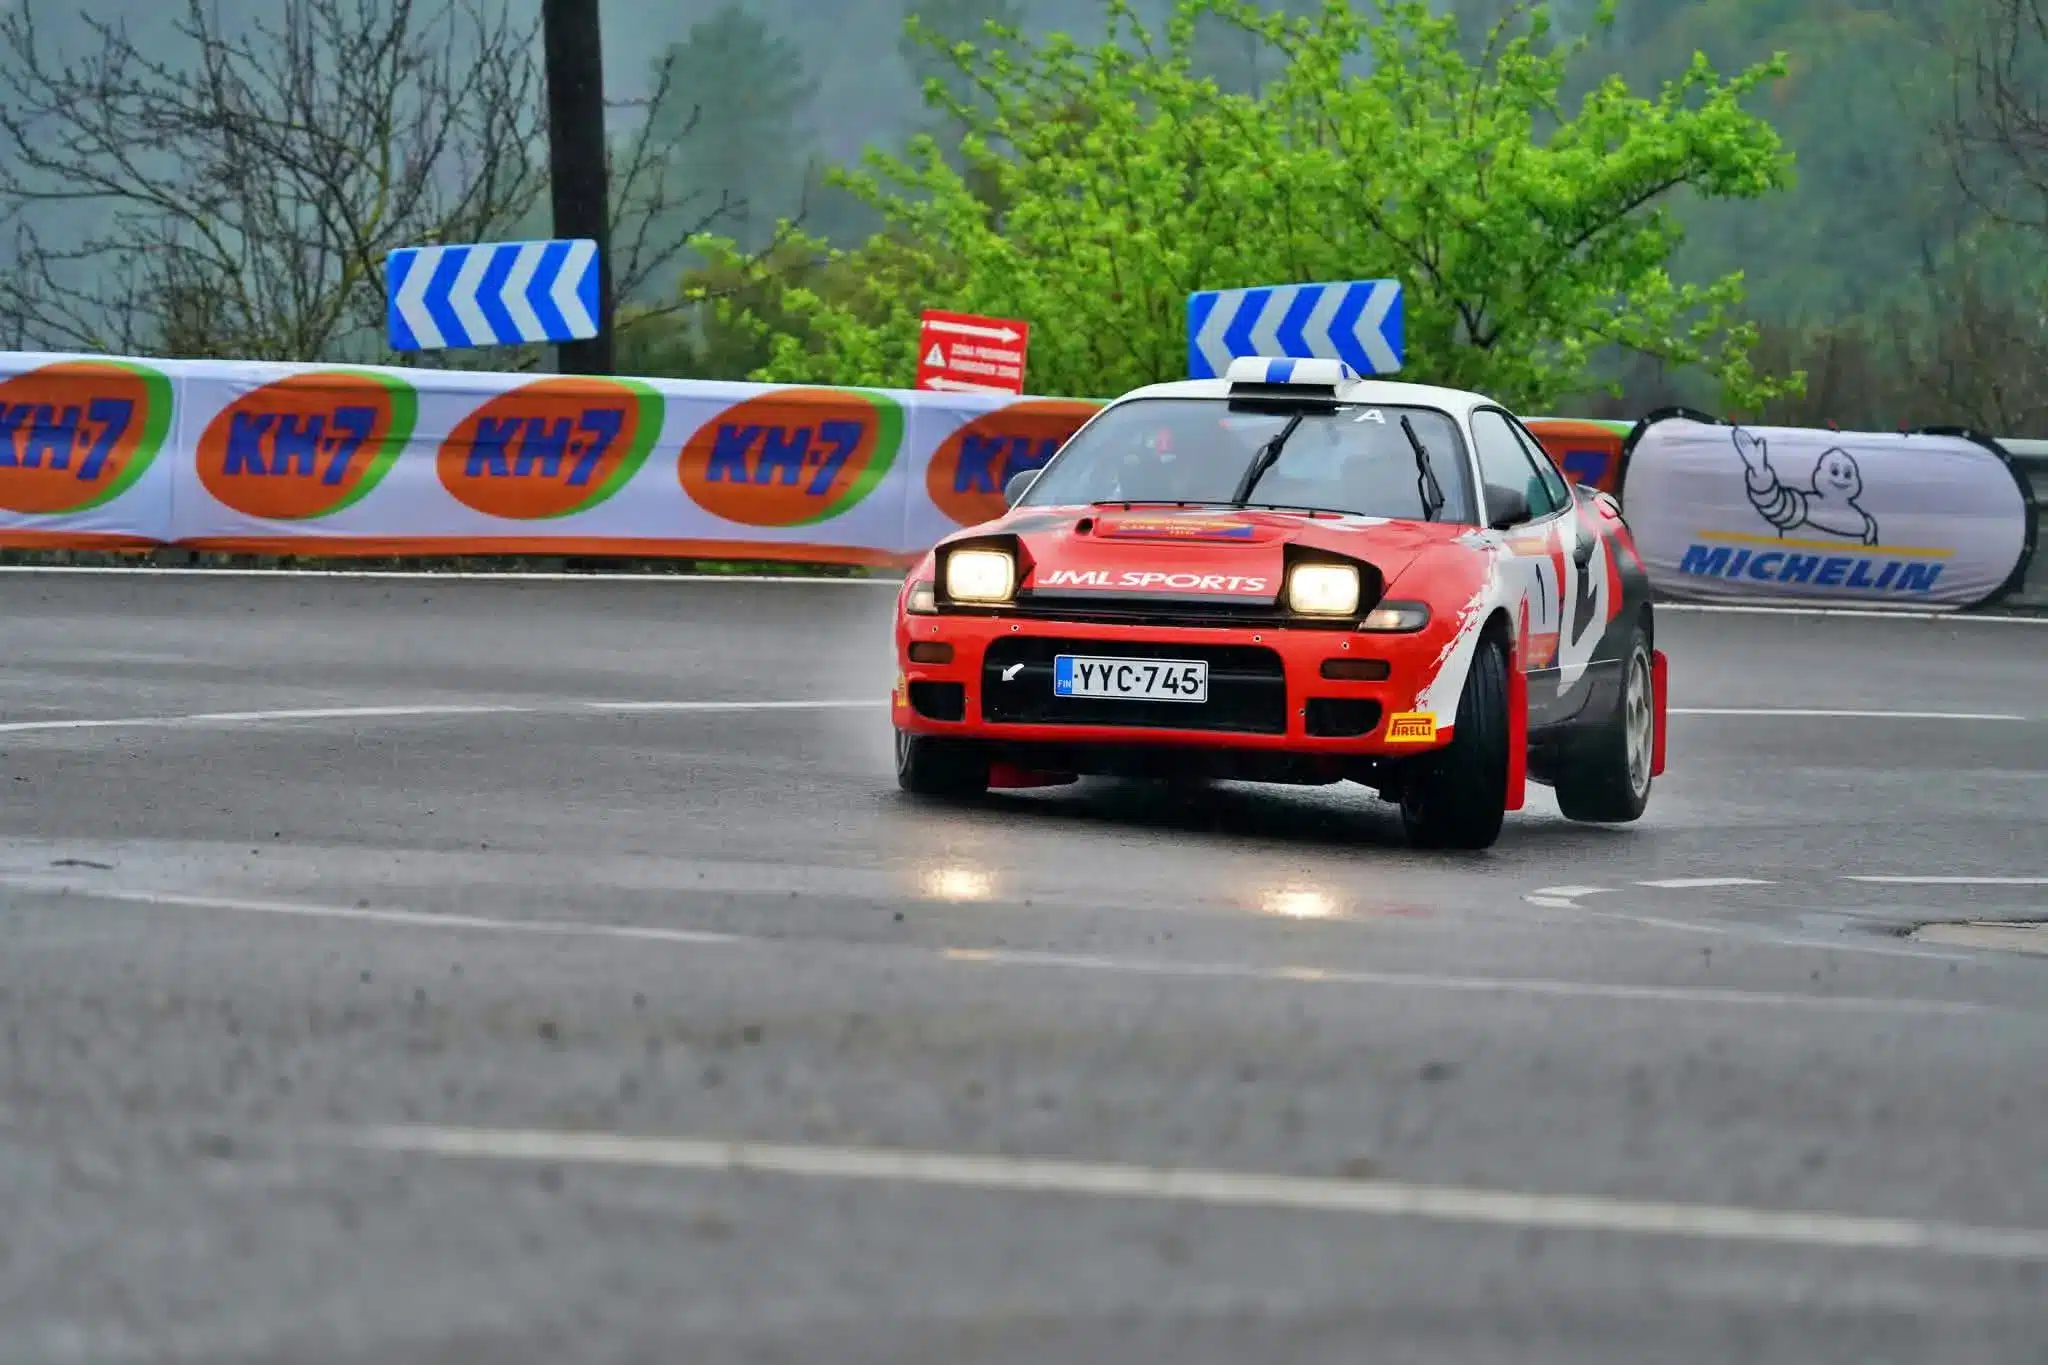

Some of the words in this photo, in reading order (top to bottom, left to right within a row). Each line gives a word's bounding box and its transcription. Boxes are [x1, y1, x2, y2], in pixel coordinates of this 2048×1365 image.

[1678, 544, 1945, 591] MICHELIN
[1038, 571, 1114, 585] JML
[1119, 571, 1268, 592] SPORTS
[1391, 718, 1432, 737] PIRELLI
